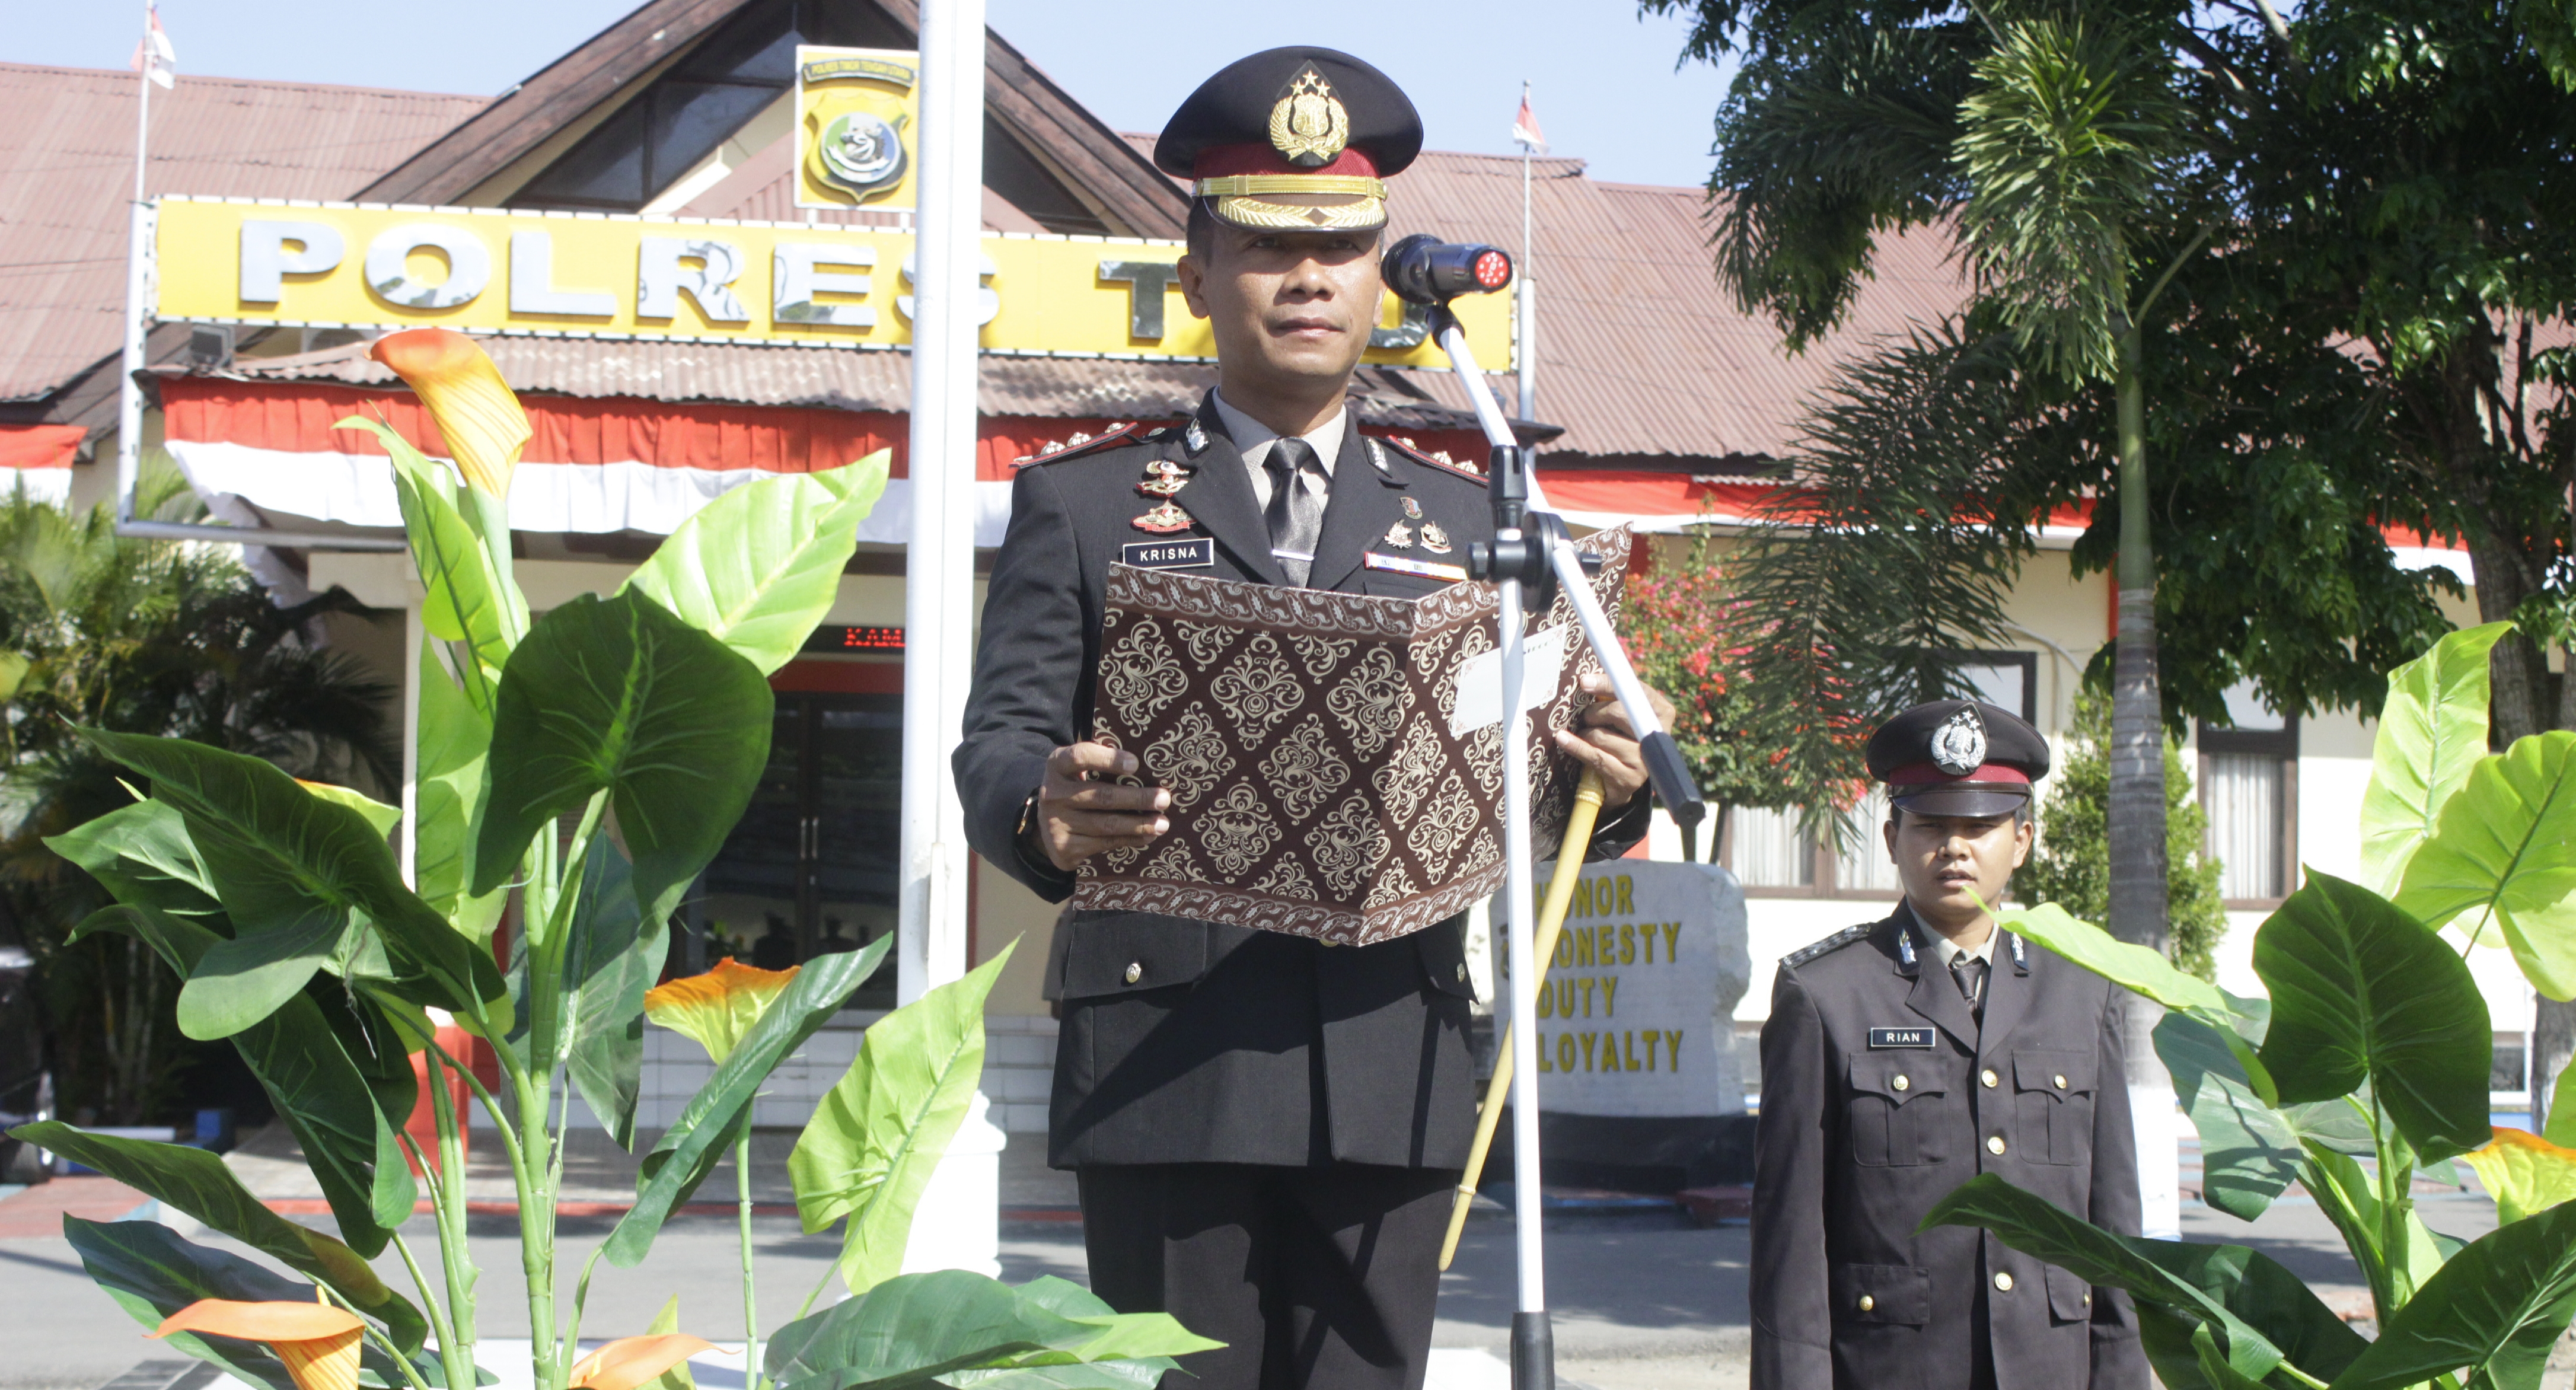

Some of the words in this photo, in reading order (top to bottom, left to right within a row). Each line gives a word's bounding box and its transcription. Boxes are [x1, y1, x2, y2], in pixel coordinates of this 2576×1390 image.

[1140, 547, 1197, 562] KRISNA
[1535, 875, 1635, 920] HNOR
[1548, 922, 1681, 970] ONESTY
[1537, 976, 1618, 1019] DUTY
[1538, 1030, 1682, 1072] LOYALTY
[1886, 1032, 1920, 1042] RIAN
